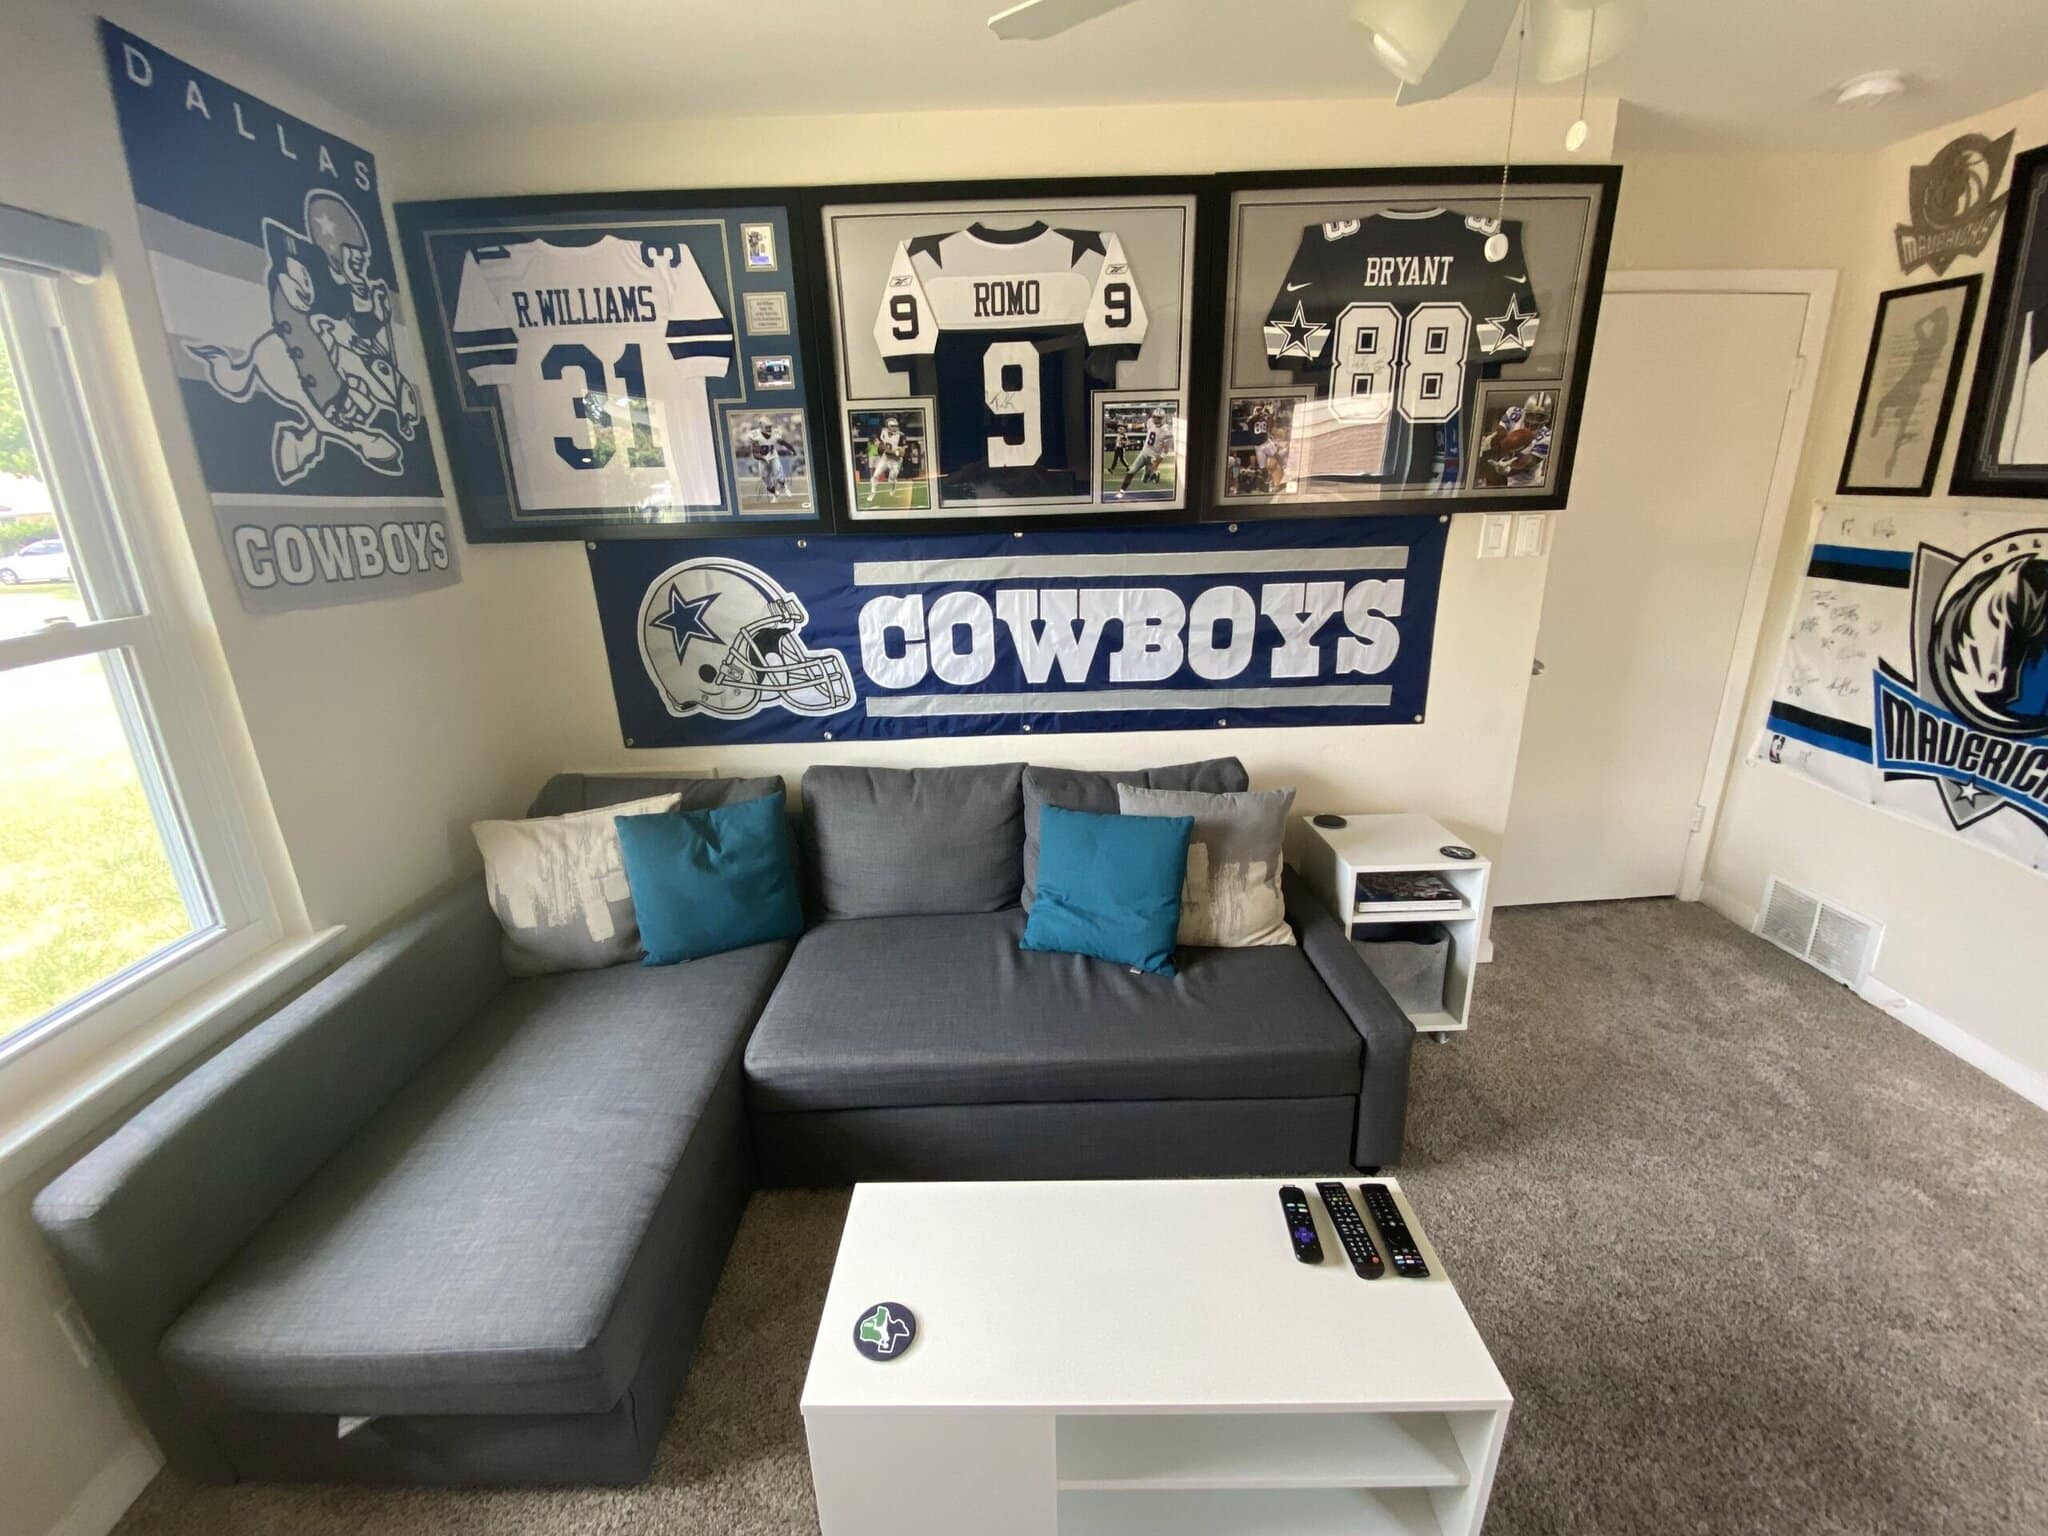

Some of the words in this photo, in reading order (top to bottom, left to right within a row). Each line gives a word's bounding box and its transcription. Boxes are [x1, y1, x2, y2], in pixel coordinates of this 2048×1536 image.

[122, 41, 371, 193] DALLAS
[511, 284, 657, 329] R.WILLIAMS
[889, 294, 920, 341] 9
[973, 279, 1041, 318] ROMO
[1103, 282, 1132, 329] 9
[1363, 255, 1454, 288] BRYANT
[540, 342, 667, 472] 31
[982, 340, 1043, 468] 9
[1327, 301, 1471, 424] 88
[233, 520, 451, 590] COWBOYS
[857, 578, 1404, 692] COWBOYS
[1882, 689, 2048, 803] MAVERIC
